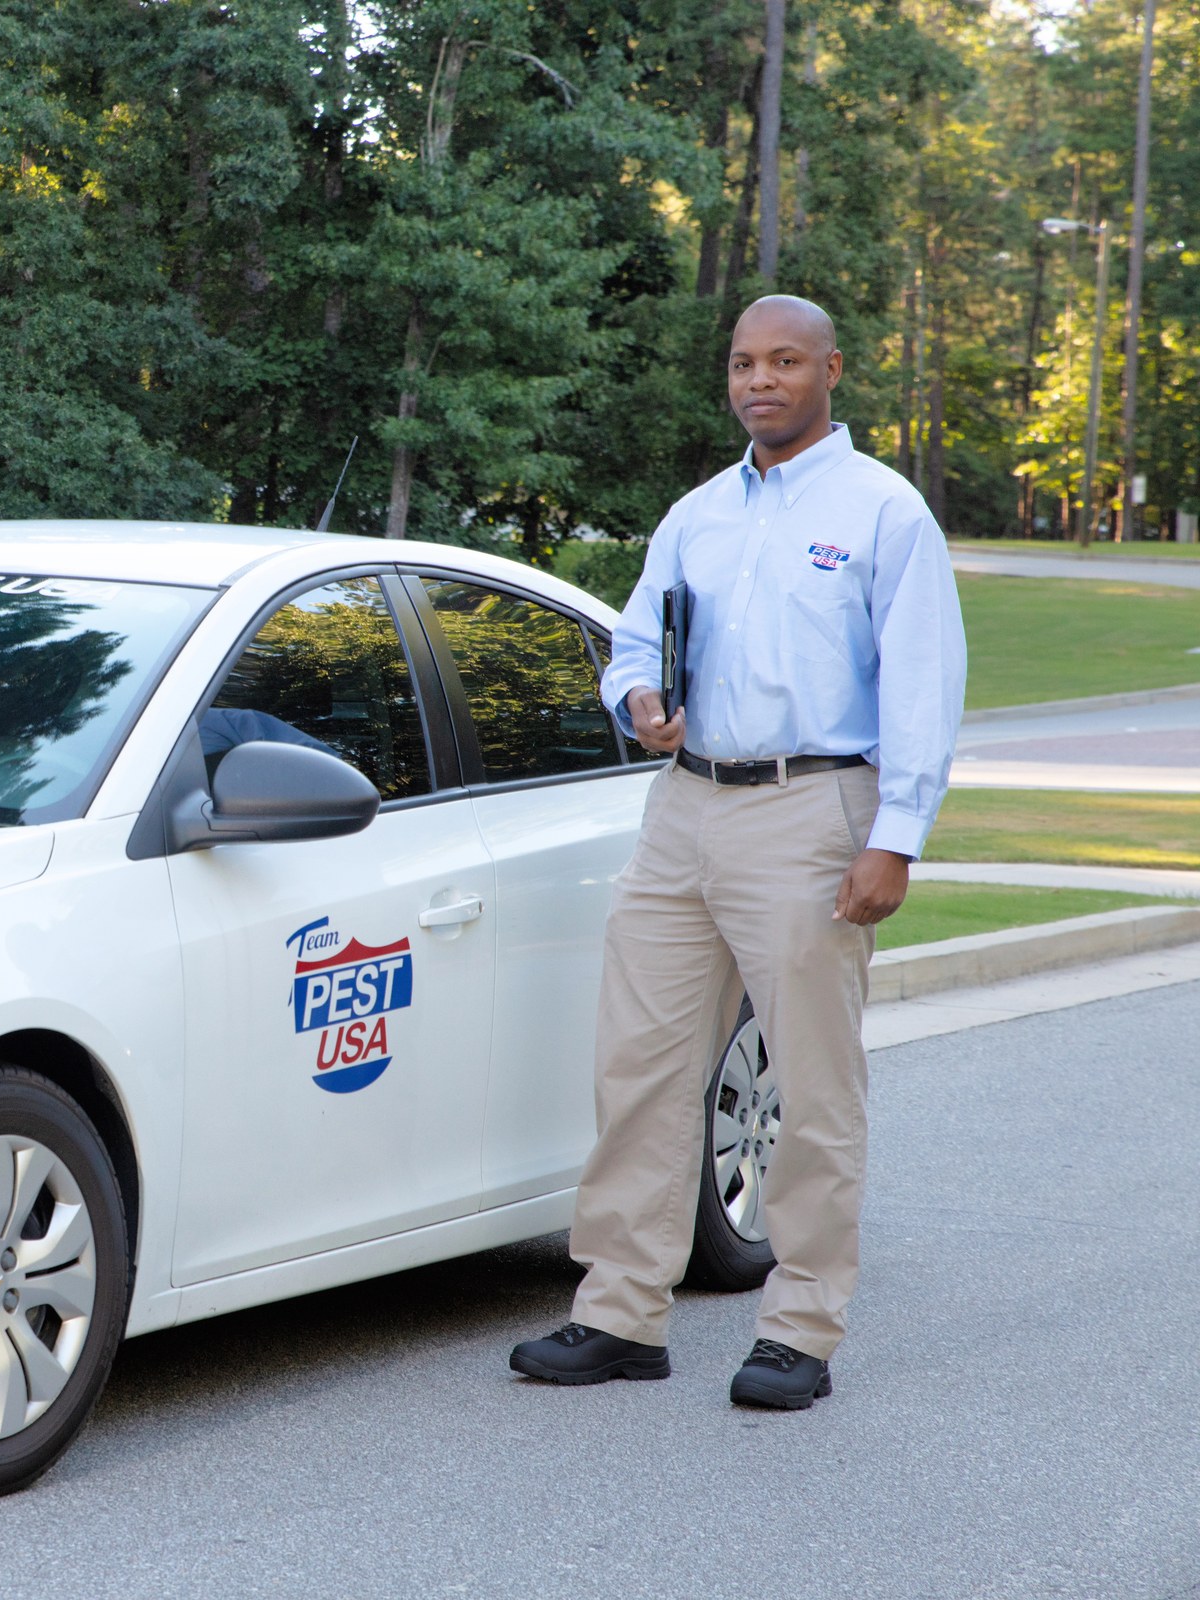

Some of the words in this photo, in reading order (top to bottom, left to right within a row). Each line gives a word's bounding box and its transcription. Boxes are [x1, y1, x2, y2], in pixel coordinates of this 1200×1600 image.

[812, 547, 847, 561] PEST
[812, 556, 837, 568] USA
[0, 576, 123, 601] USA
[286, 915, 340, 959] Team
[302, 957, 404, 1029] PEST
[316, 1016, 388, 1071] USA
